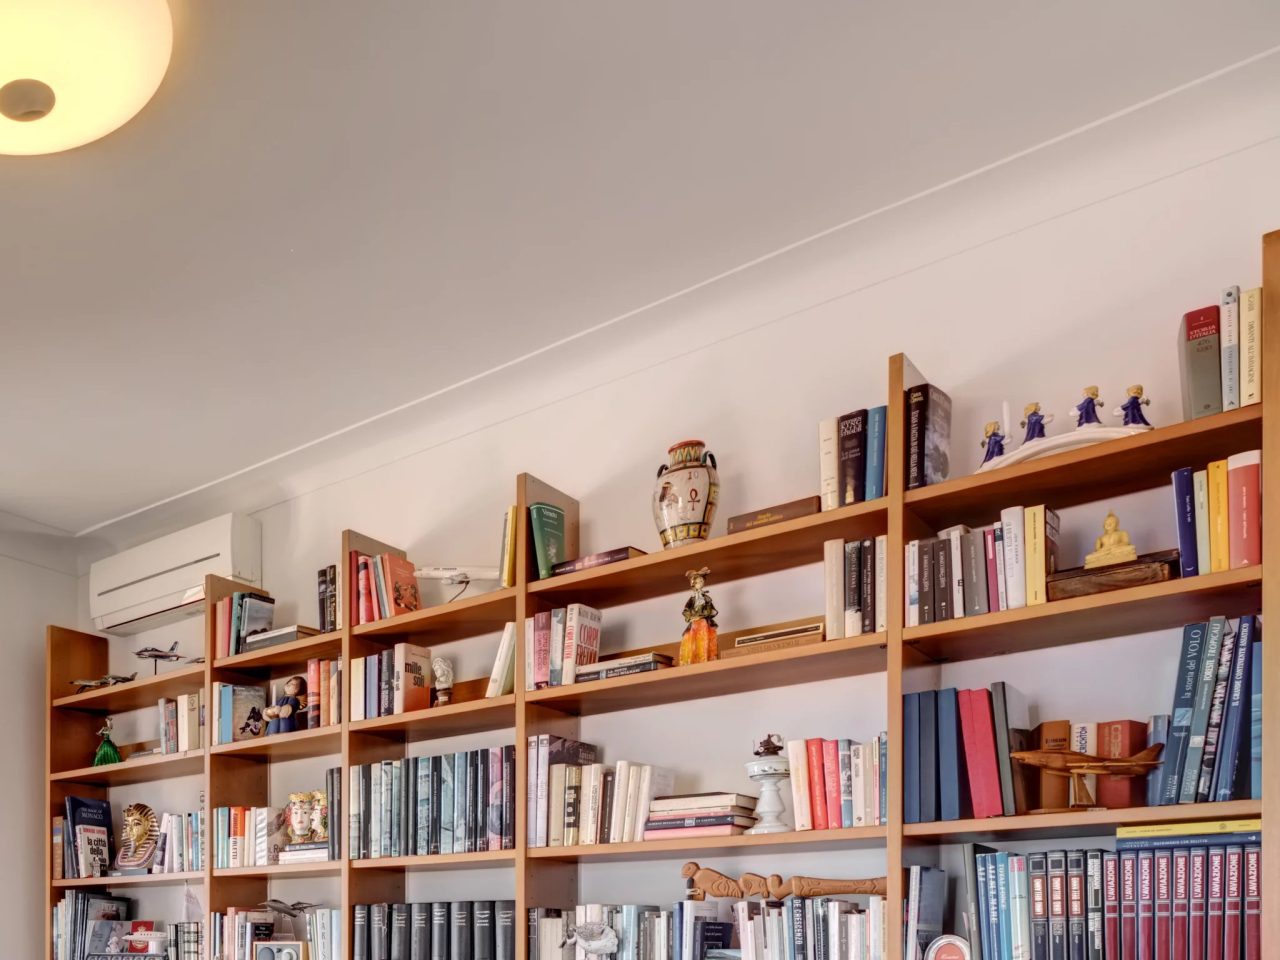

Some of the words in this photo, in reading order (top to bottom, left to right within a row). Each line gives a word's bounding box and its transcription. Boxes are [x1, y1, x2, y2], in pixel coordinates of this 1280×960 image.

[1188, 630, 1202, 657] VOLO
[1208, 624, 1221, 657] TROPICALI
[405, 663, 422, 676] mille
[1184, 660, 1196, 670] del
[1235, 647, 1246, 679] CONTINENTE
[413, 675, 425, 687] soli
[1183, 671, 1195, 690] storia
[87, 837, 92, 845] la
[94, 839, 106, 847] città
[1107, 860, 1116, 900] L'AVIAZIONE
[1142, 858, 1150, 899] L'AVIAZIONE
[1159, 858, 1167, 898] L'AVIAZIONE
[1177, 857, 1185, 898] L'AVIAZIONE
[1194, 857, 1202, 898] L'AVIAZIONE
[1212, 855, 1220, 897] L'AVIAZIONE
[1230, 854, 1238, 896] L'AVIAZIONE
[1249, 853, 1257, 896] L'AVIAZIONE
[793, 899, 801, 911] DE
[794, 913, 803, 945] CRESCENZO
